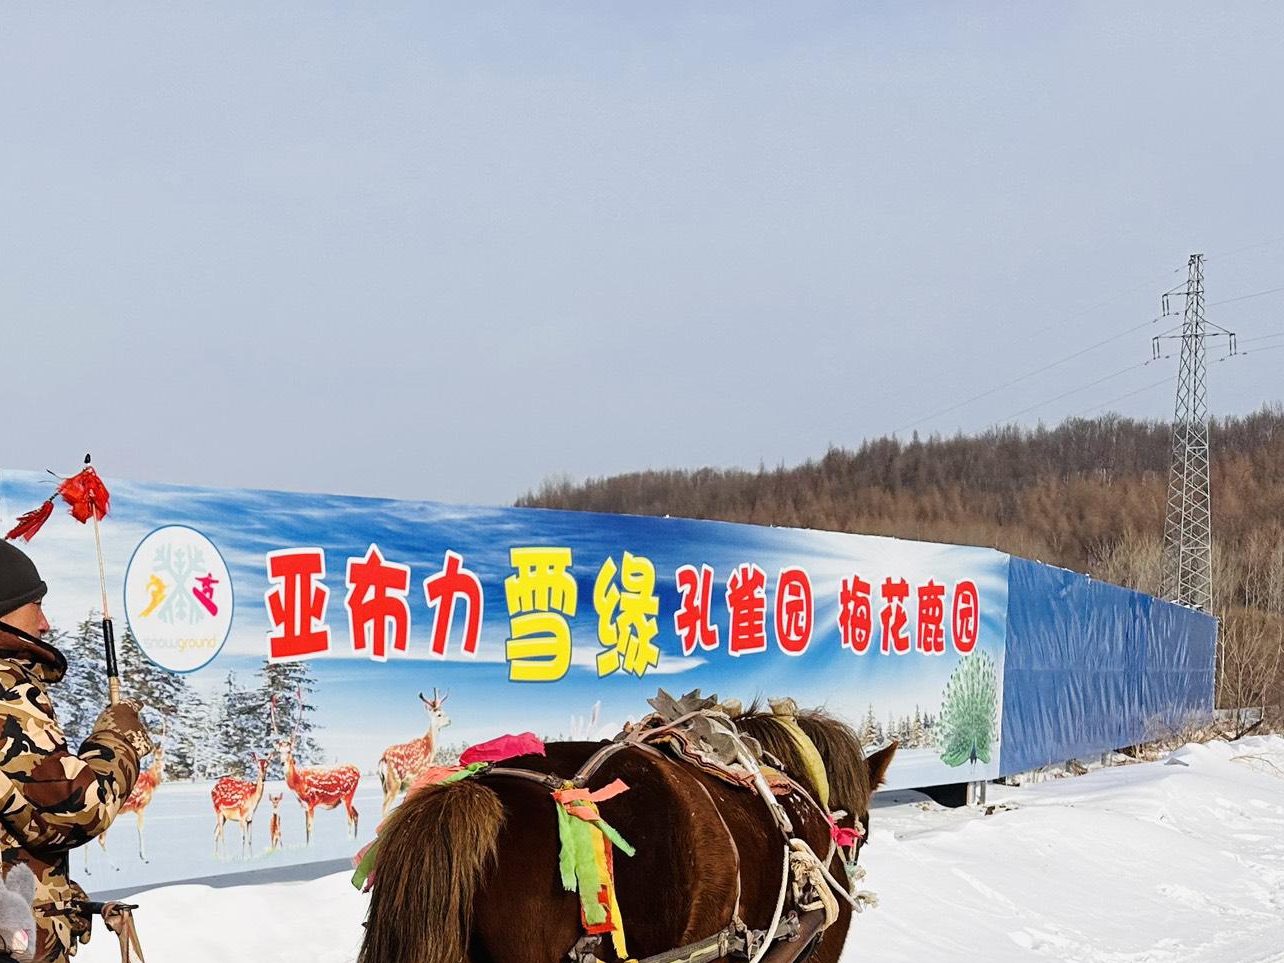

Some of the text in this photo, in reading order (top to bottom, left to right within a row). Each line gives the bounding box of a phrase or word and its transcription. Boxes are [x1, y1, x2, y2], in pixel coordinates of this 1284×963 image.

[265, 543, 980, 682] 亚布力 雪缘 孔雀园 梅花鹿园
